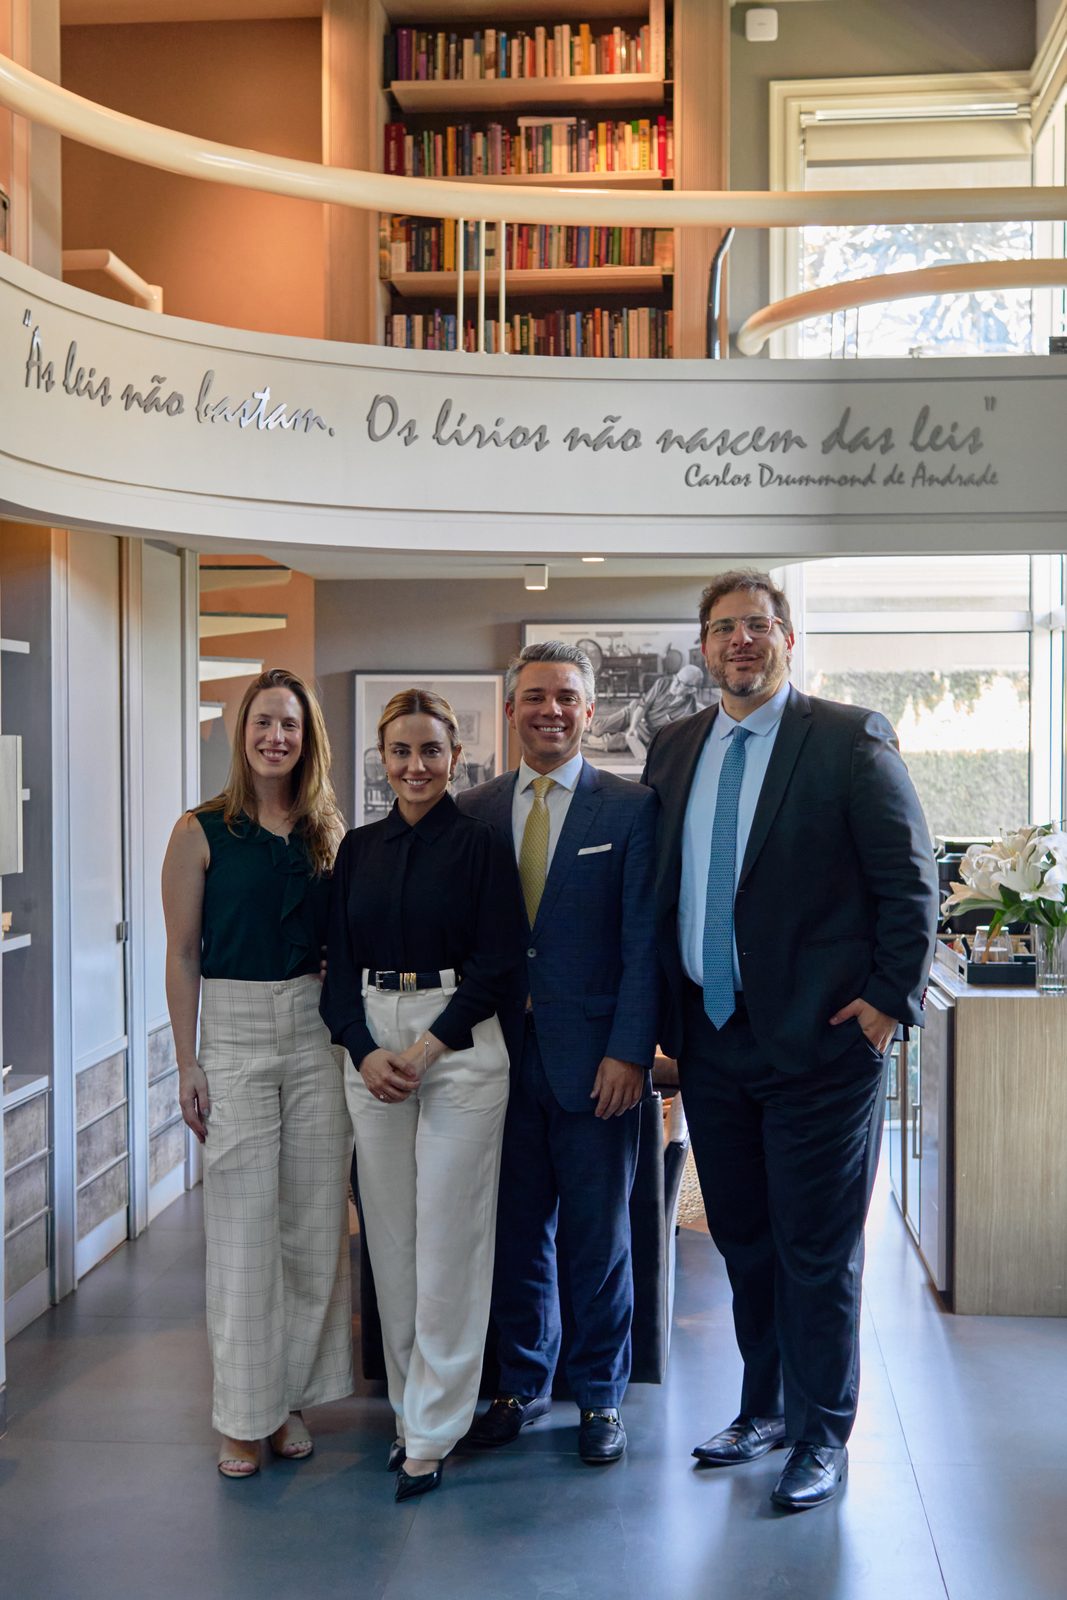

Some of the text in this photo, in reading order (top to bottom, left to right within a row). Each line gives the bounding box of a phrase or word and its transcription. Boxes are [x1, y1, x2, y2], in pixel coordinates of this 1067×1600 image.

[62, 340, 112, 407] leis
[120, 375, 185, 417] não
[195, 369, 336, 437] bastam.
[366, 394, 419, 447] Os
[432, 398, 550, 451] lírios
[563, 415, 642, 451] não
[656, 425, 807, 456] nascem
[821, 406, 896, 455] das
[909, 395, 997, 455] leis"
[684, 461, 999, 488] Carlos Drummond de Andrade
